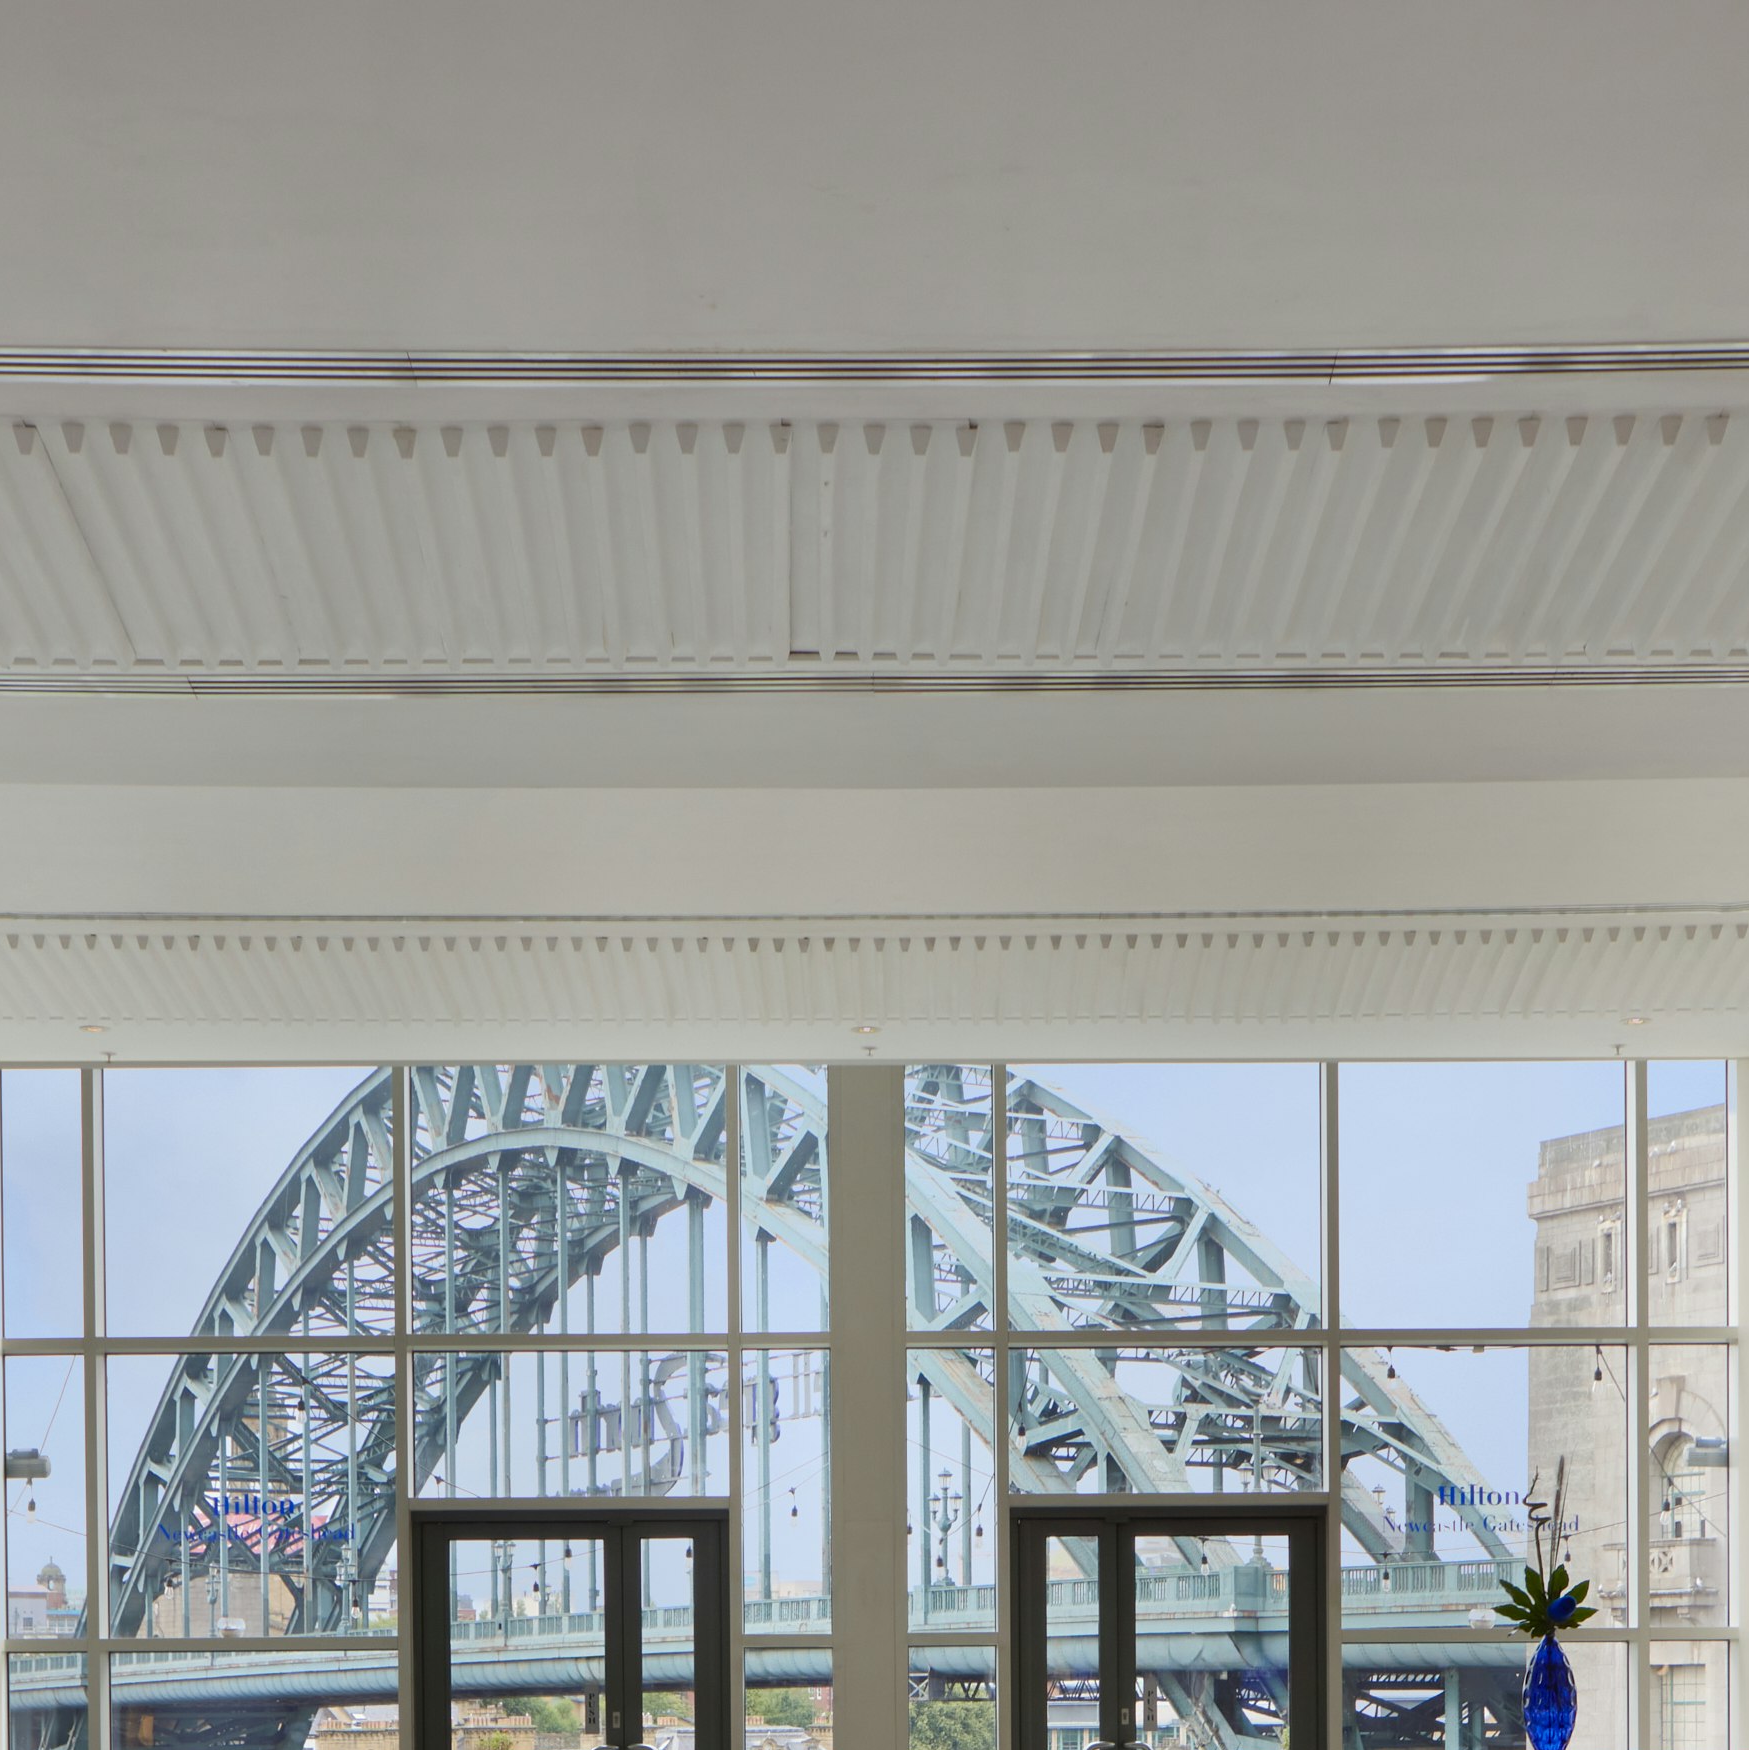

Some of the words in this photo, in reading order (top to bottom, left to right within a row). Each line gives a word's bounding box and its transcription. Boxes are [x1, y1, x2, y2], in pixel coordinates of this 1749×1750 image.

[213, 1493, 295, 1516] Hilton
[1438, 1483, 1519, 1506] Hilton
[1382, 1515, 1474, 1533] Newcastle
